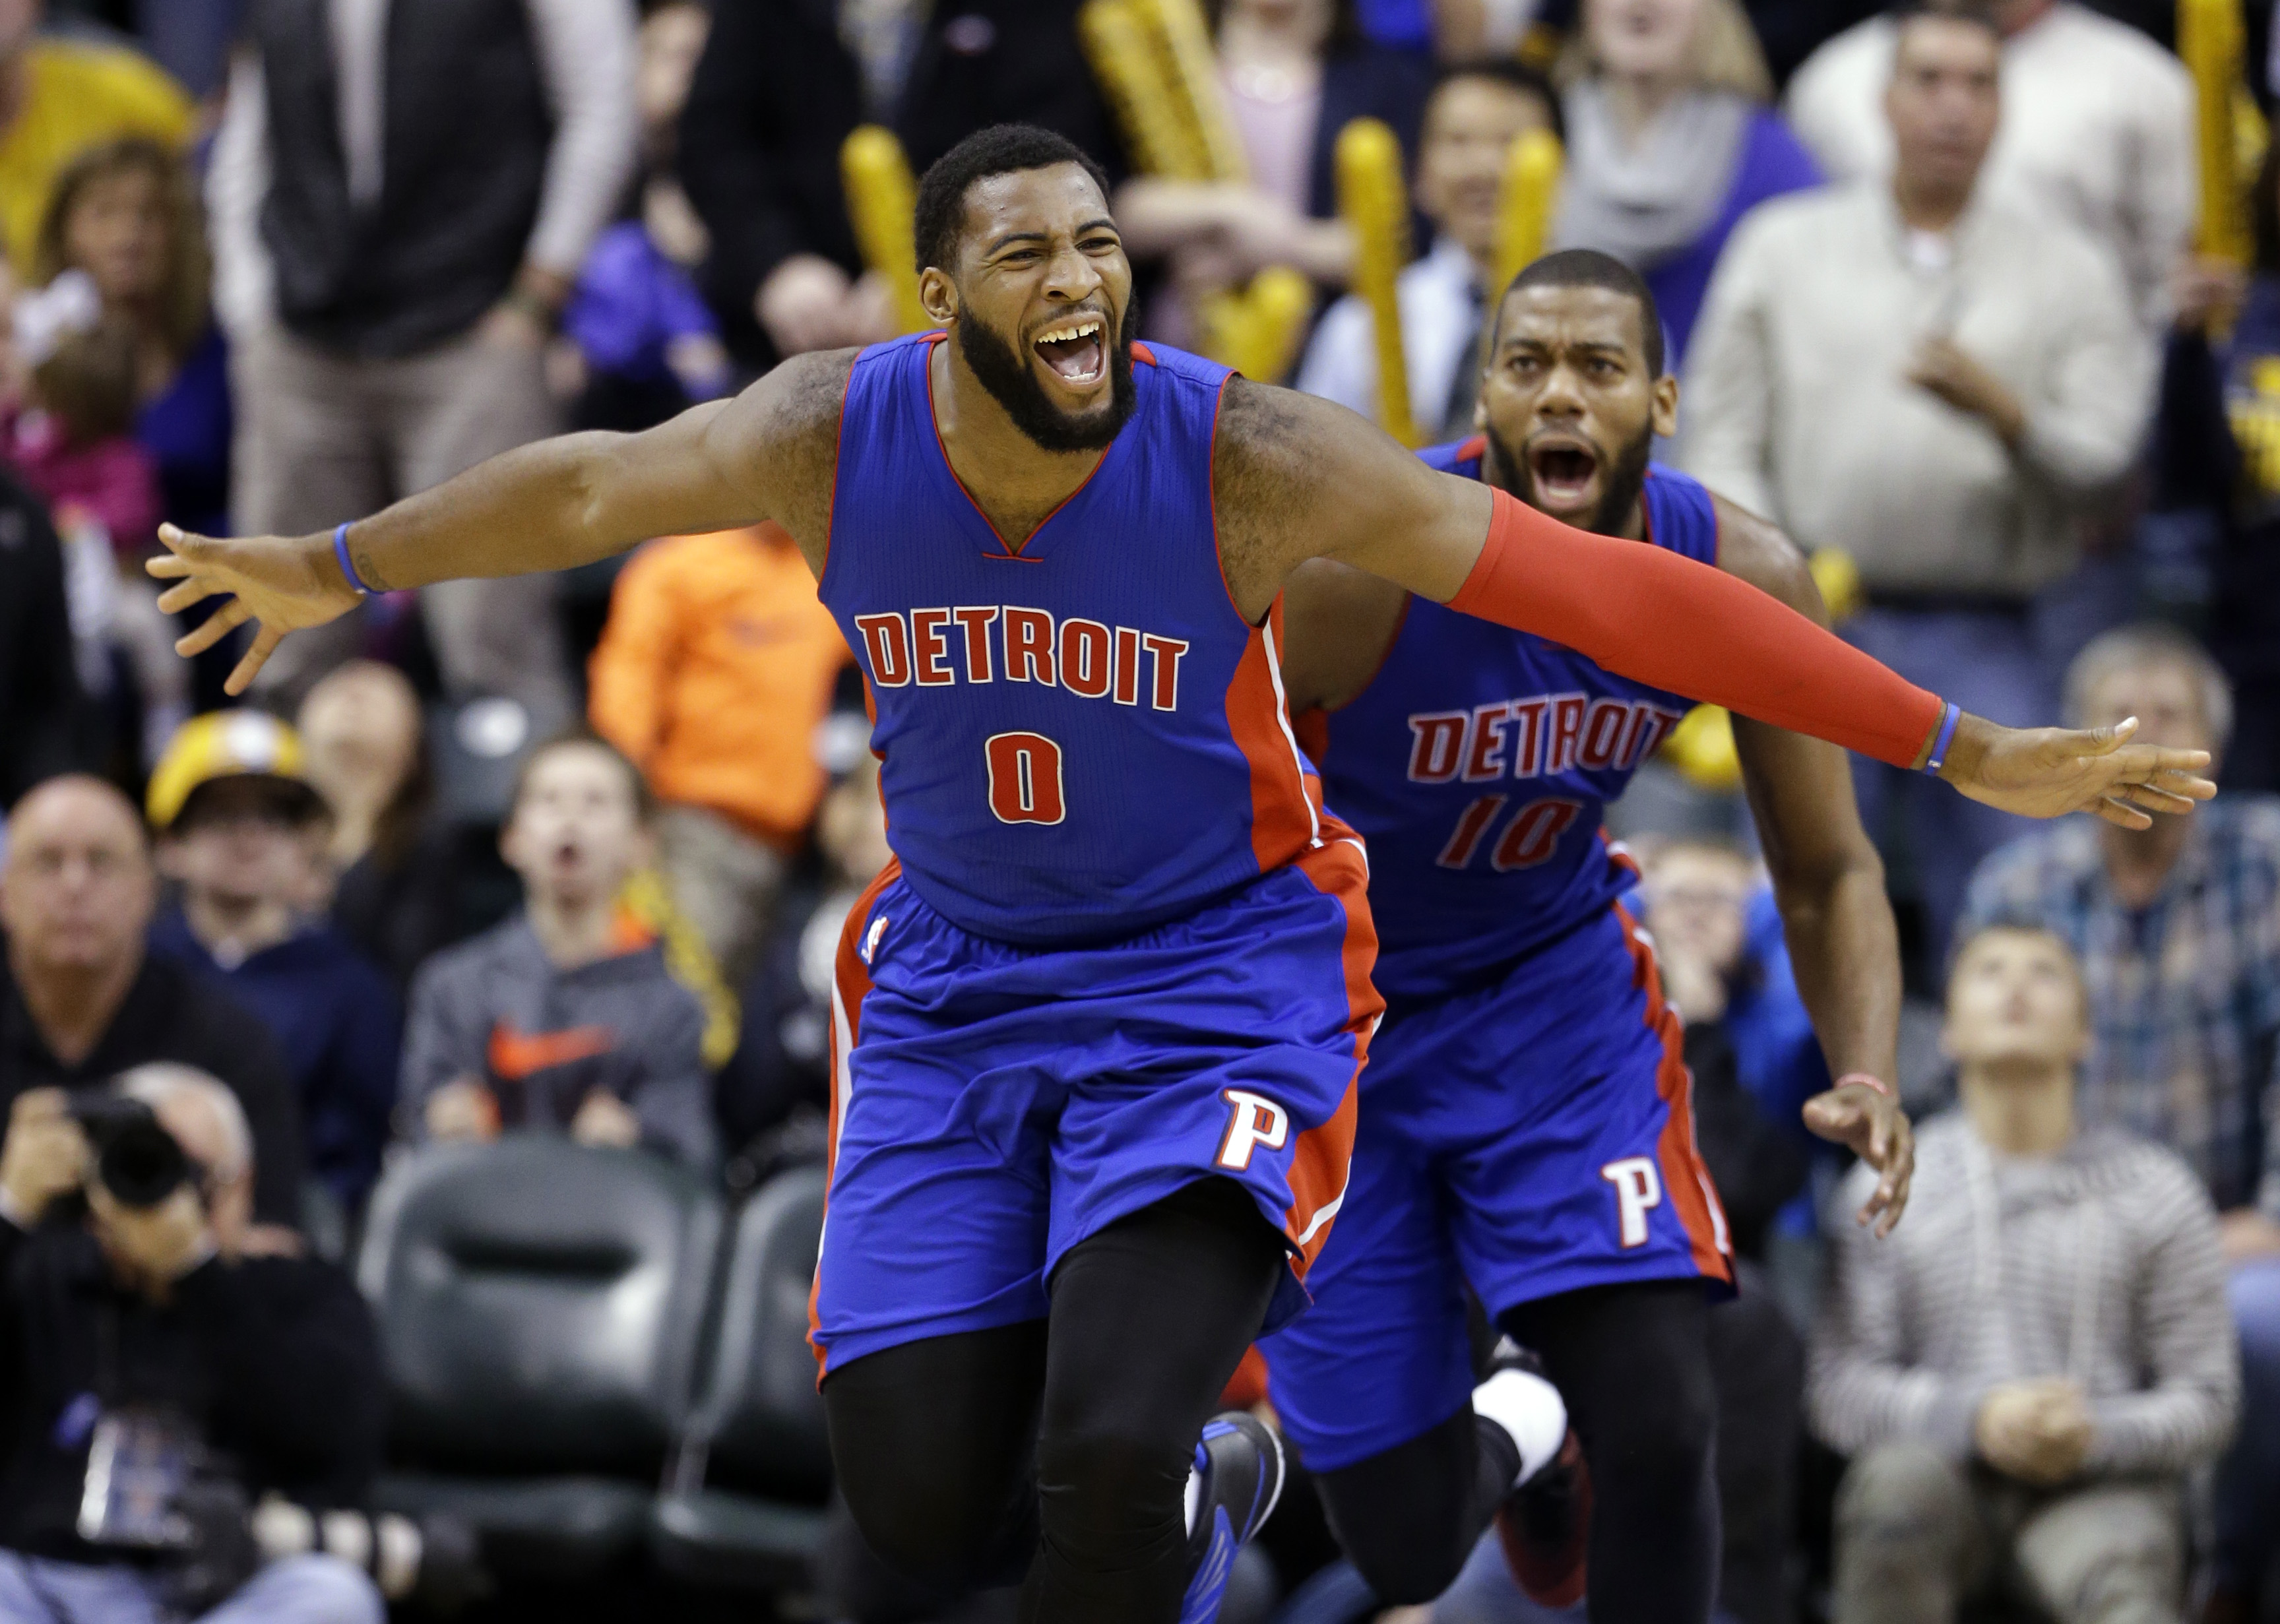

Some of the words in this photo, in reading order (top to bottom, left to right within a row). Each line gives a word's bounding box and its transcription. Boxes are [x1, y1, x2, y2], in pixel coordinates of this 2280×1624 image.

[854, 605, 1189, 712] DETROIT
[985, 731, 1065, 825] 0
[1407, 691, 1684, 784] DETROIT
[1436, 794, 1583, 873] 10
[1214, 1087, 1289, 1171] P
[1600, 1156, 1661, 1249] P
